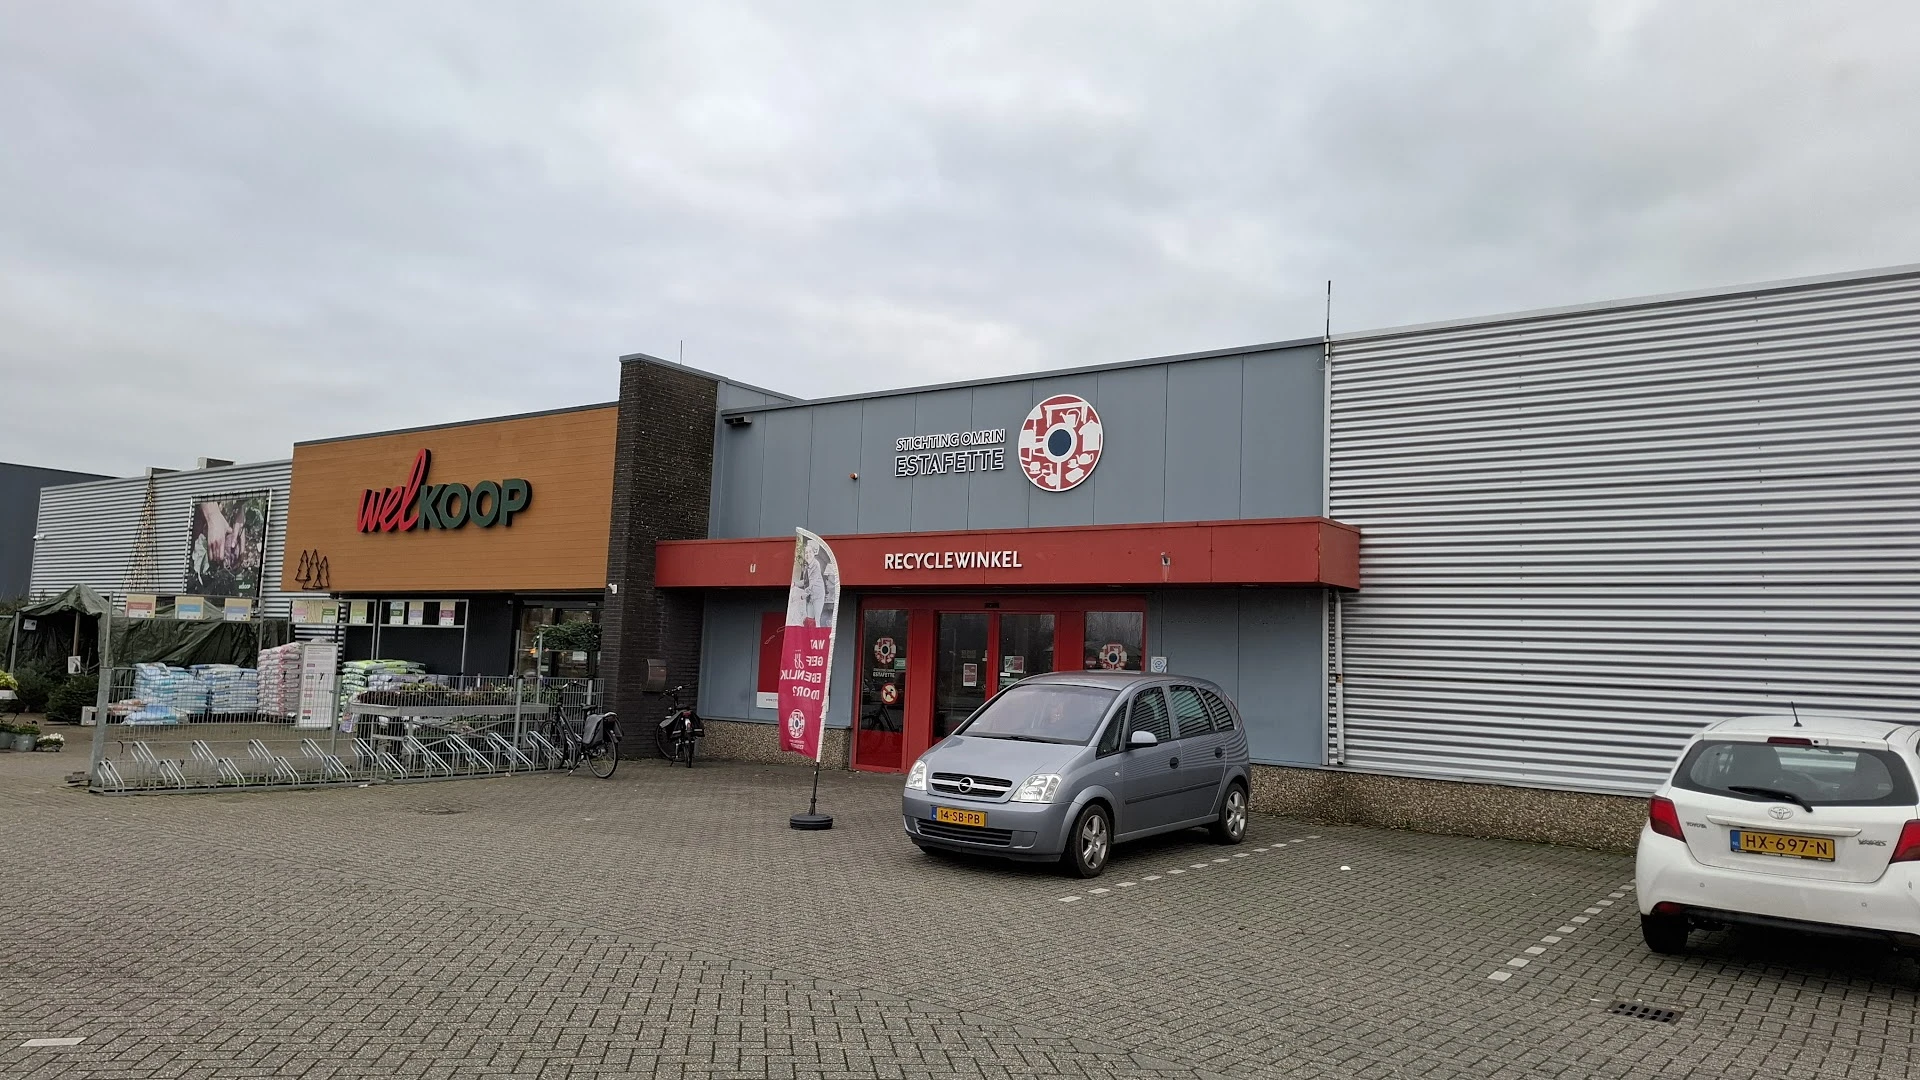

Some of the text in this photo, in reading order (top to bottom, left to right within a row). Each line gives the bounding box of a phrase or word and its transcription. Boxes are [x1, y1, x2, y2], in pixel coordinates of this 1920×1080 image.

[895, 428, 1006, 451] STICHTING OMRIN
[894, 447, 1005, 477] ESTAFETTE
[884, 550, 1023, 570] RECYCLEWINKEL
[940, 809, 980, 825] 14-SB-PB
[1746, 834, 1828, 855] HX-697-N
